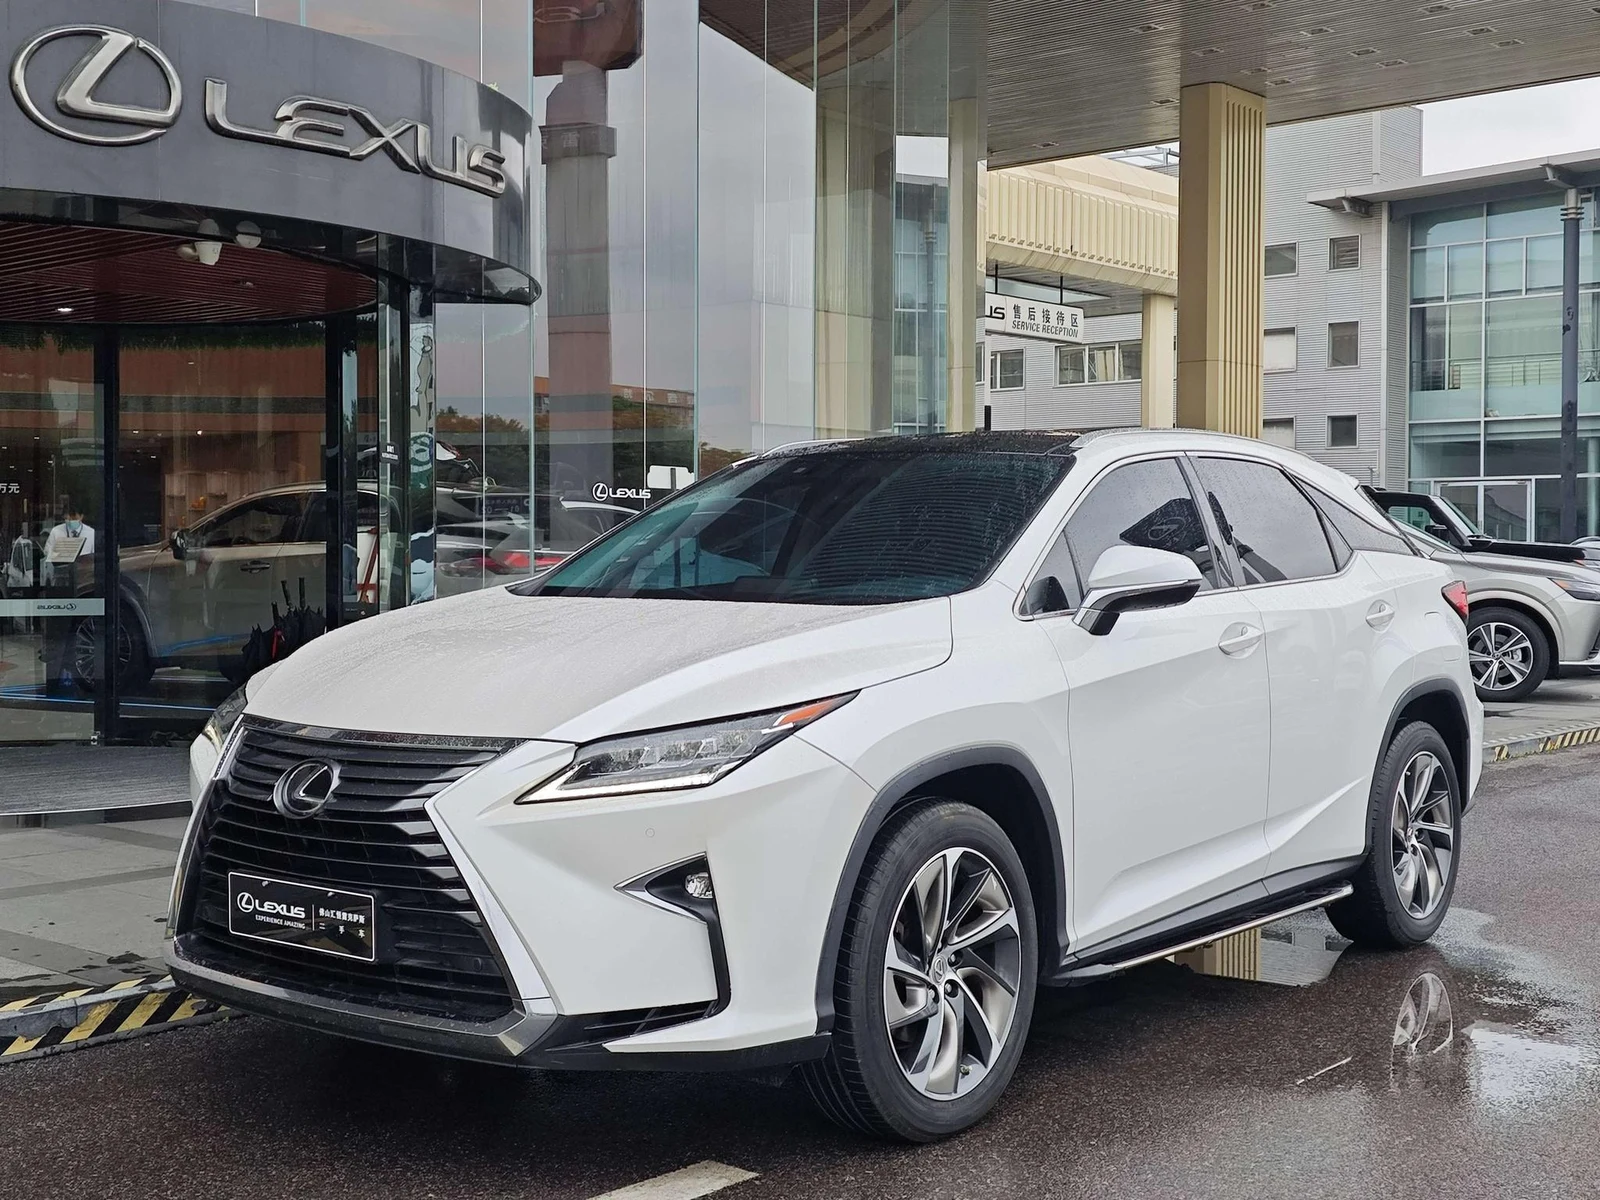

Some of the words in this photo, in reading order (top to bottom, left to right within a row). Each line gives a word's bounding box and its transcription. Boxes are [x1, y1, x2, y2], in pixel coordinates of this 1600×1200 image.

[204, 78, 506, 199] LEXUS
[1012, 303, 1079, 328] 售后接待区
[1011, 319, 1041, 333] SERVICE
[1041, 323, 1079, 338] RECEPTION
[609, 487, 651, 499] LEXUS
[255, 899, 306, 919] LEXUS
[255, 914, 284, 926] EXPERIENCE
[283, 920, 306, 930] AMAZING
